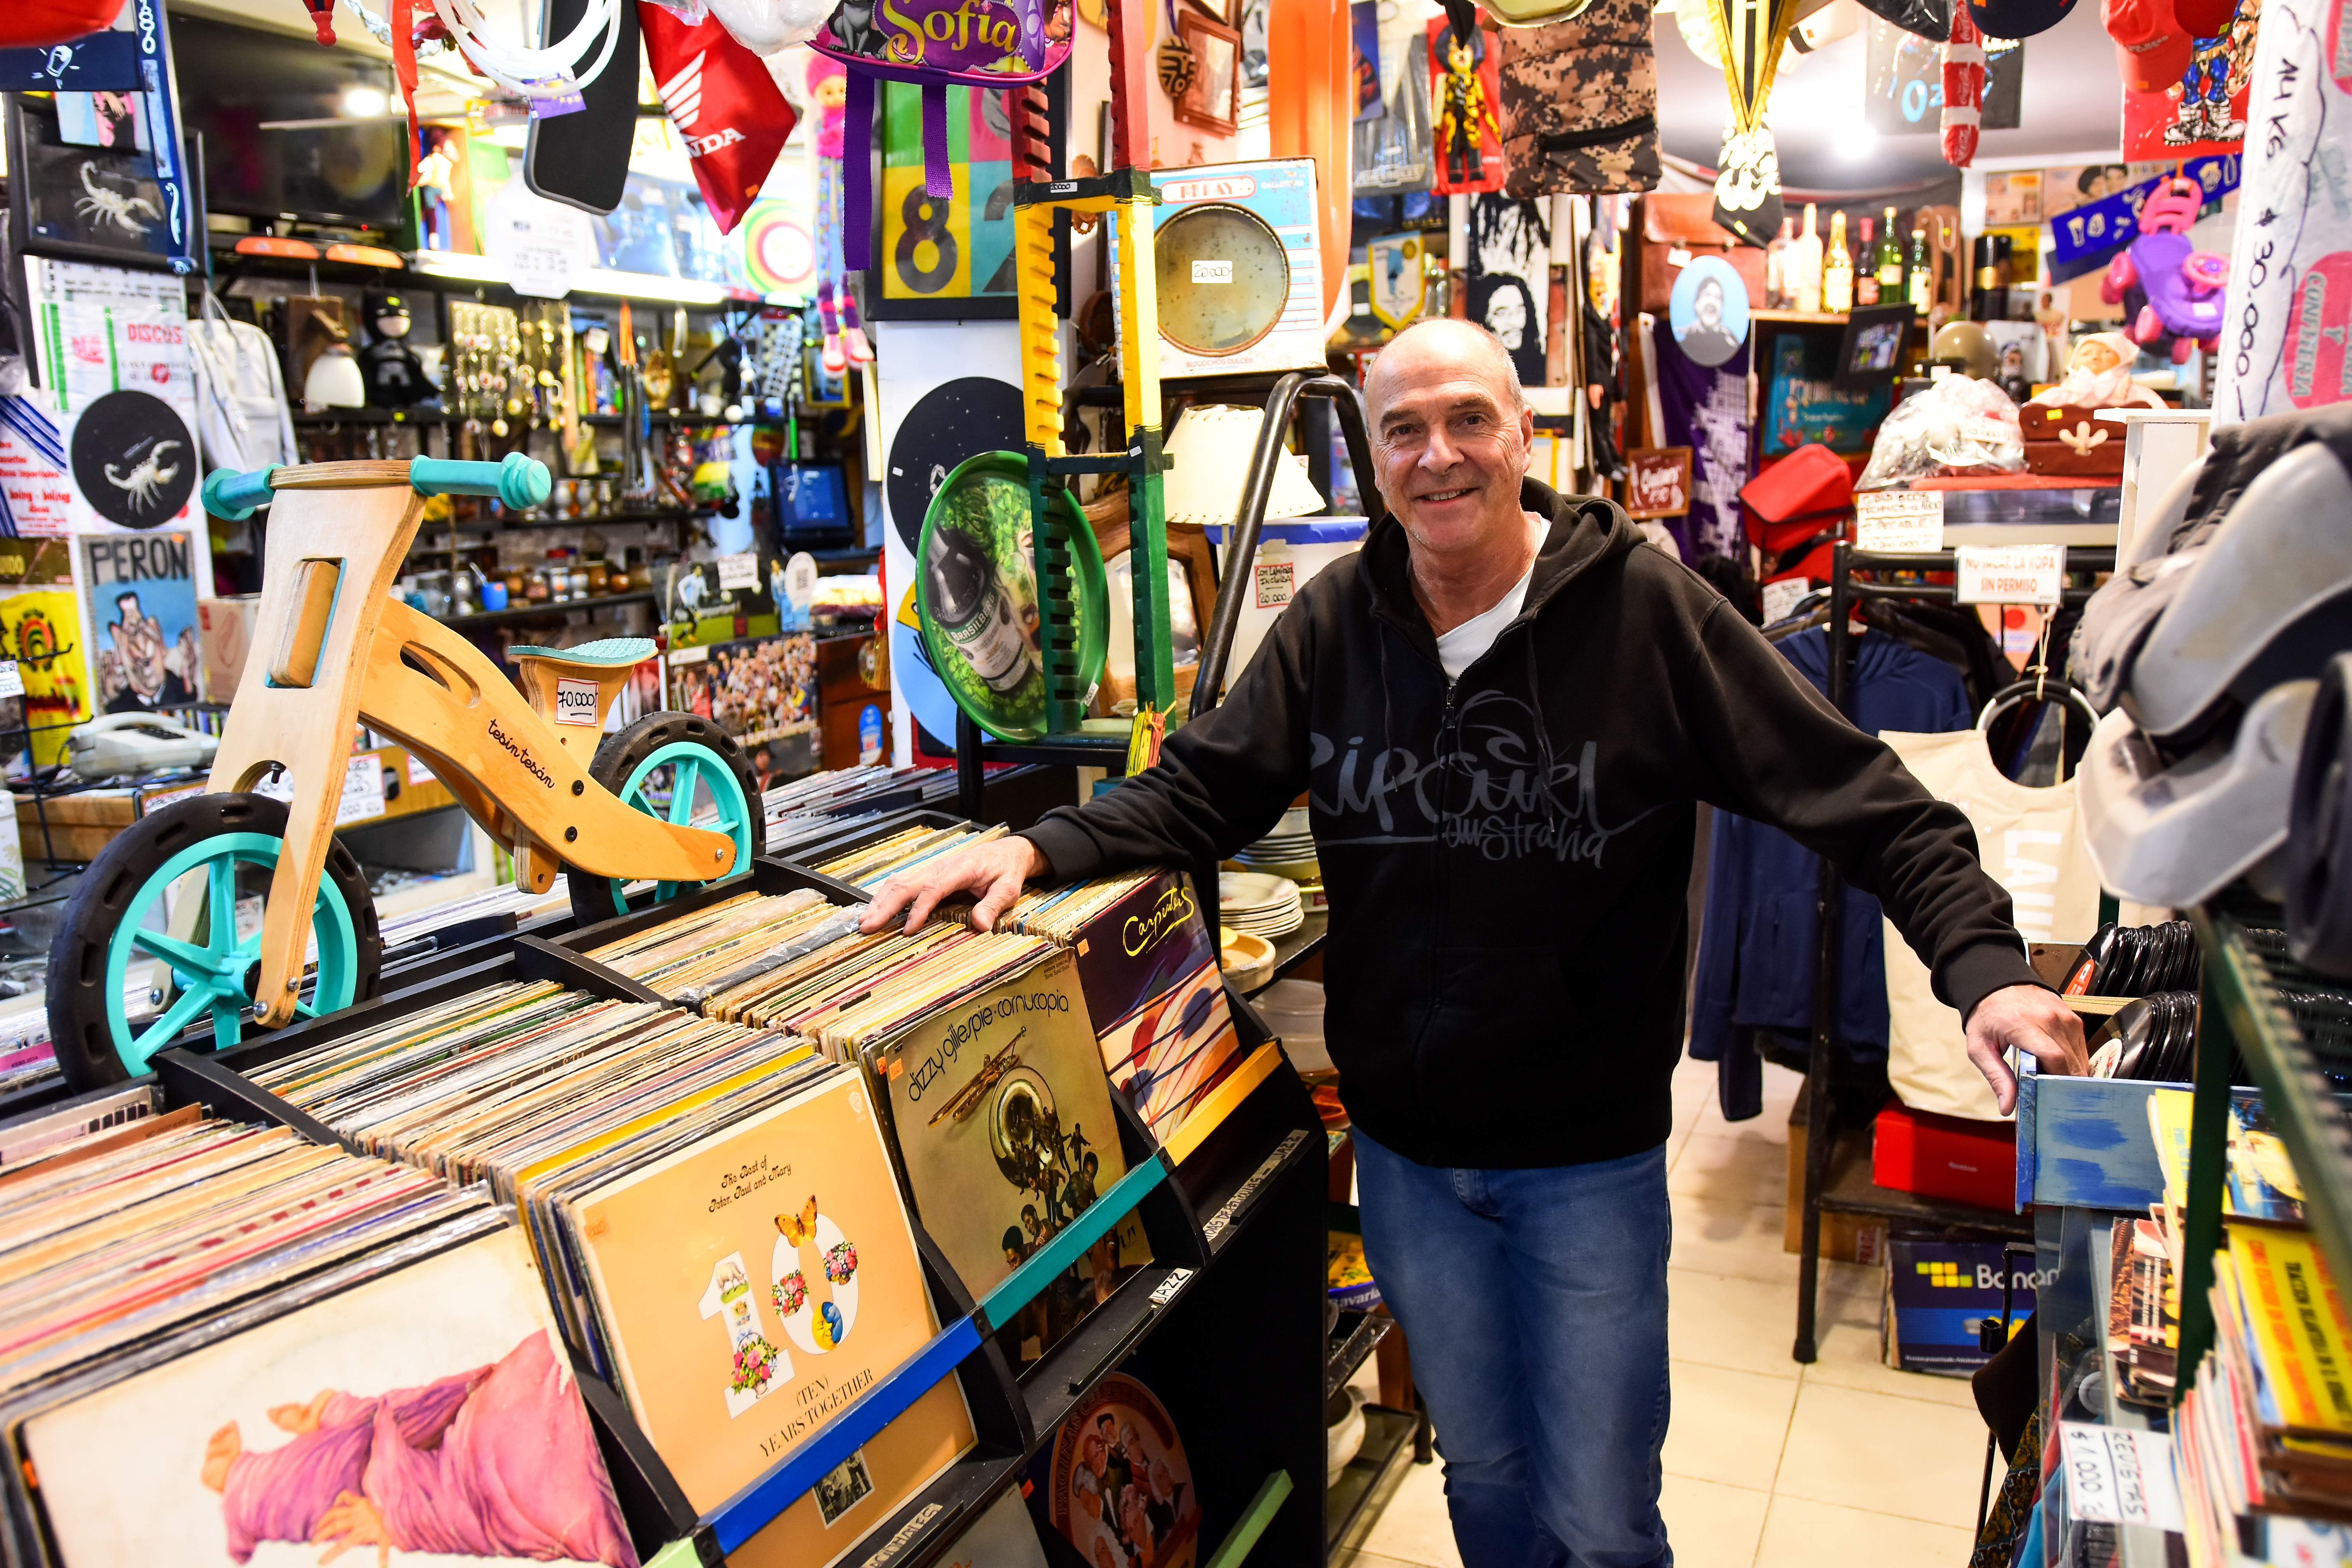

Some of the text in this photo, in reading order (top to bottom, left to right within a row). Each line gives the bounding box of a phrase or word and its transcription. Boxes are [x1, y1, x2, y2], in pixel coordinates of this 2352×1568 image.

[681, 126, 746, 159] NDA
[127, 323, 182, 344] DISCOS
[2292, 271, 2327, 398] CONFITERIA
[2323, 325, 2345, 345] Y
[1186, 359, 1226, 367] BIZCOCHOS
[89, 535, 189, 585] PERON
[2014, 555, 2025, 569] LA
[2029, 555, 2055, 570] ROPA
[1981, 577, 2038, 592] SIN PERMISO
[951, 591, 995, 641] BRASILBERG
[1123, 885, 1194, 957] Carpenters
[909, 989, 1069, 1102] dizzy gillespie cornucopia
[720, 1154, 768, 1189] The Best of
[733, 1182, 752, 1200] Paul
[753, 1174, 767, 1192] and
[768, 1162, 793, 1185] Mary
[1154, 1271, 1189, 1304] JAZZ
[796, 1374, 829, 1408] (TEN)
[759, 1368, 874, 1459] YEARS TOGETHER
